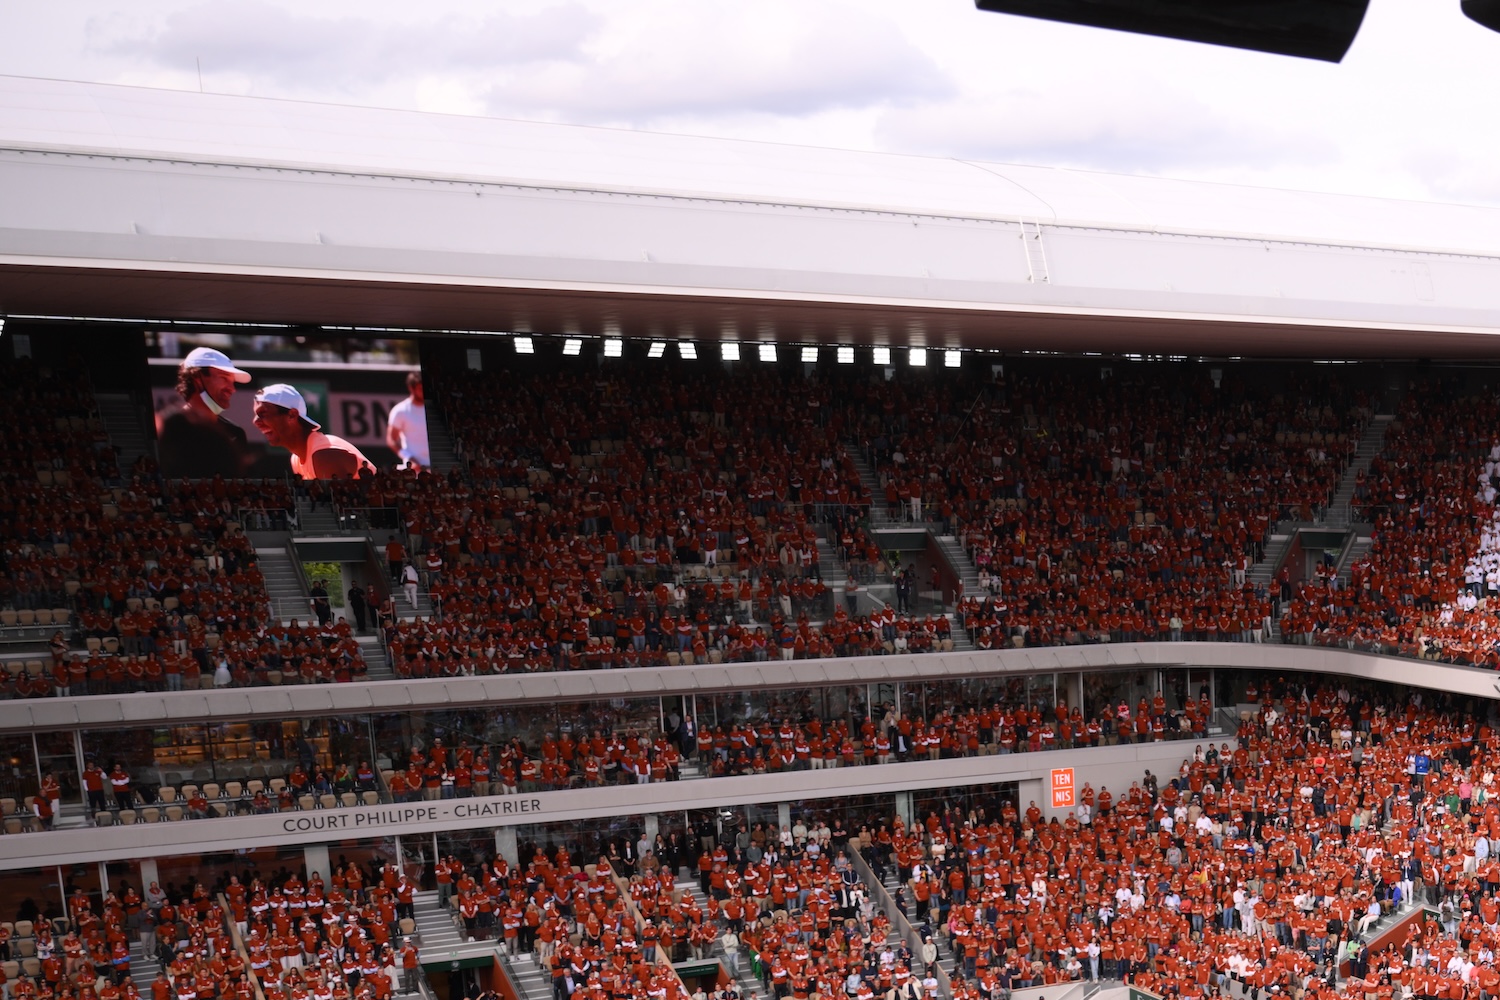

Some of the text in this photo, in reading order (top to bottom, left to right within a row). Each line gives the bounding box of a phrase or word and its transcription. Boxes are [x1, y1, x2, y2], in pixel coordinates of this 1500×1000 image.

[1054, 773, 1071, 785] TEN
[1055, 790, 1071, 803] NIS
[283, 814, 349, 832] COURT
[355, 806, 438, 826] PHILIPPE
[454, 799, 541, 818] CHATRIER
